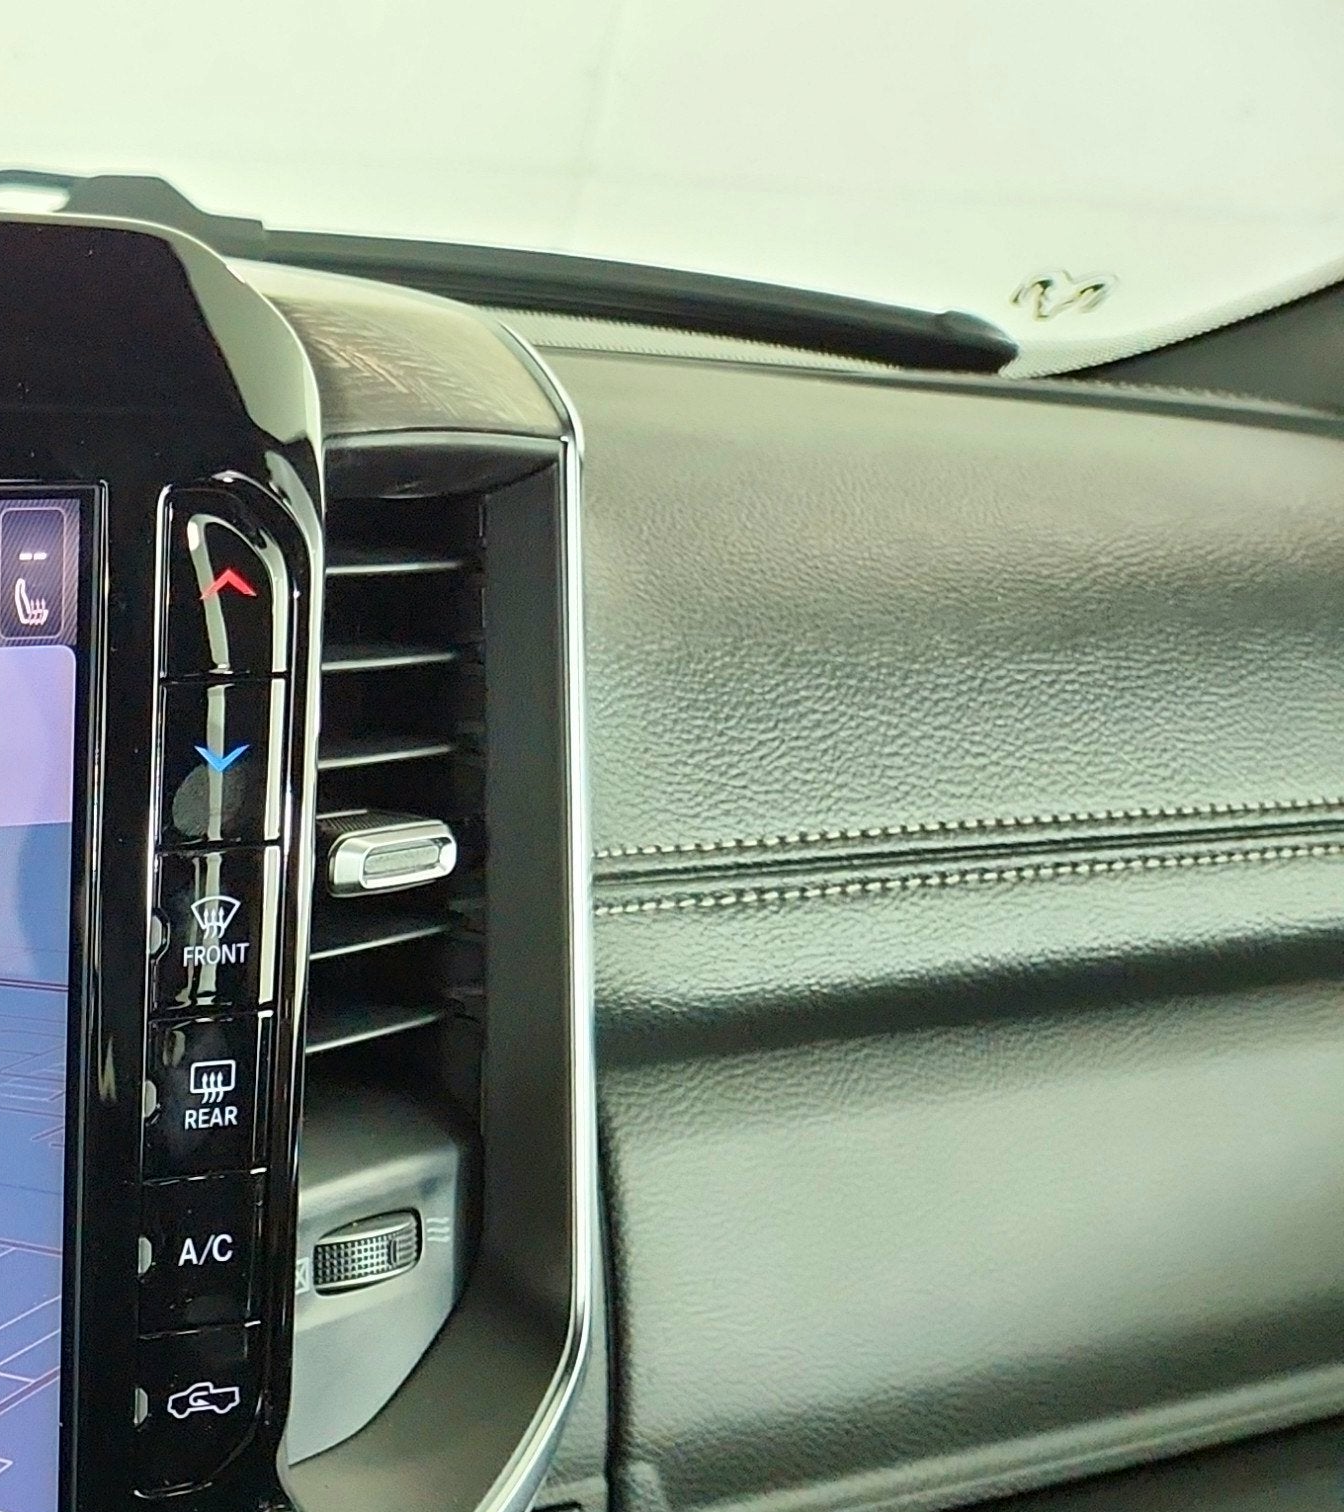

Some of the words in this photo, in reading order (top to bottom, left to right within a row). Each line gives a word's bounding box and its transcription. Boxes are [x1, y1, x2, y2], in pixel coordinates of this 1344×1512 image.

[183, 942, 250, 968] FRONT
[184, 1105, 238, 1130] REAR
[178, 1233, 233, 1267] A/C
